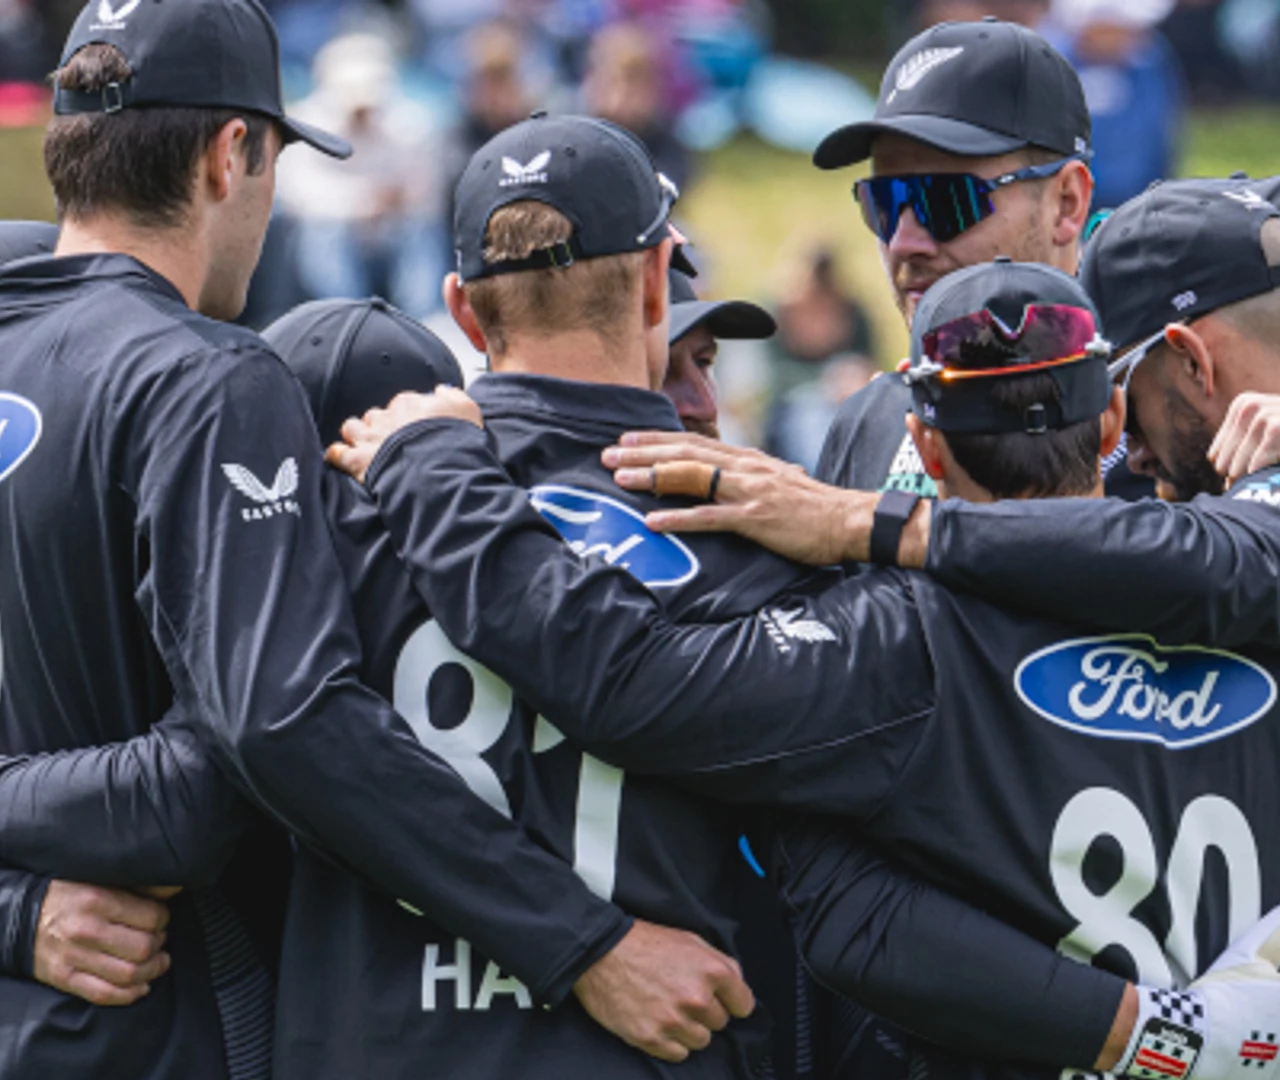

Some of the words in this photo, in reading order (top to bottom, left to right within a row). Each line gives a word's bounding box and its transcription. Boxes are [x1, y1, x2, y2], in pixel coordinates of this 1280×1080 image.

[1068, 646, 1222, 730] Ford
[1049, 786, 1262, 991] 80
[421, 936, 551, 1011] HA
